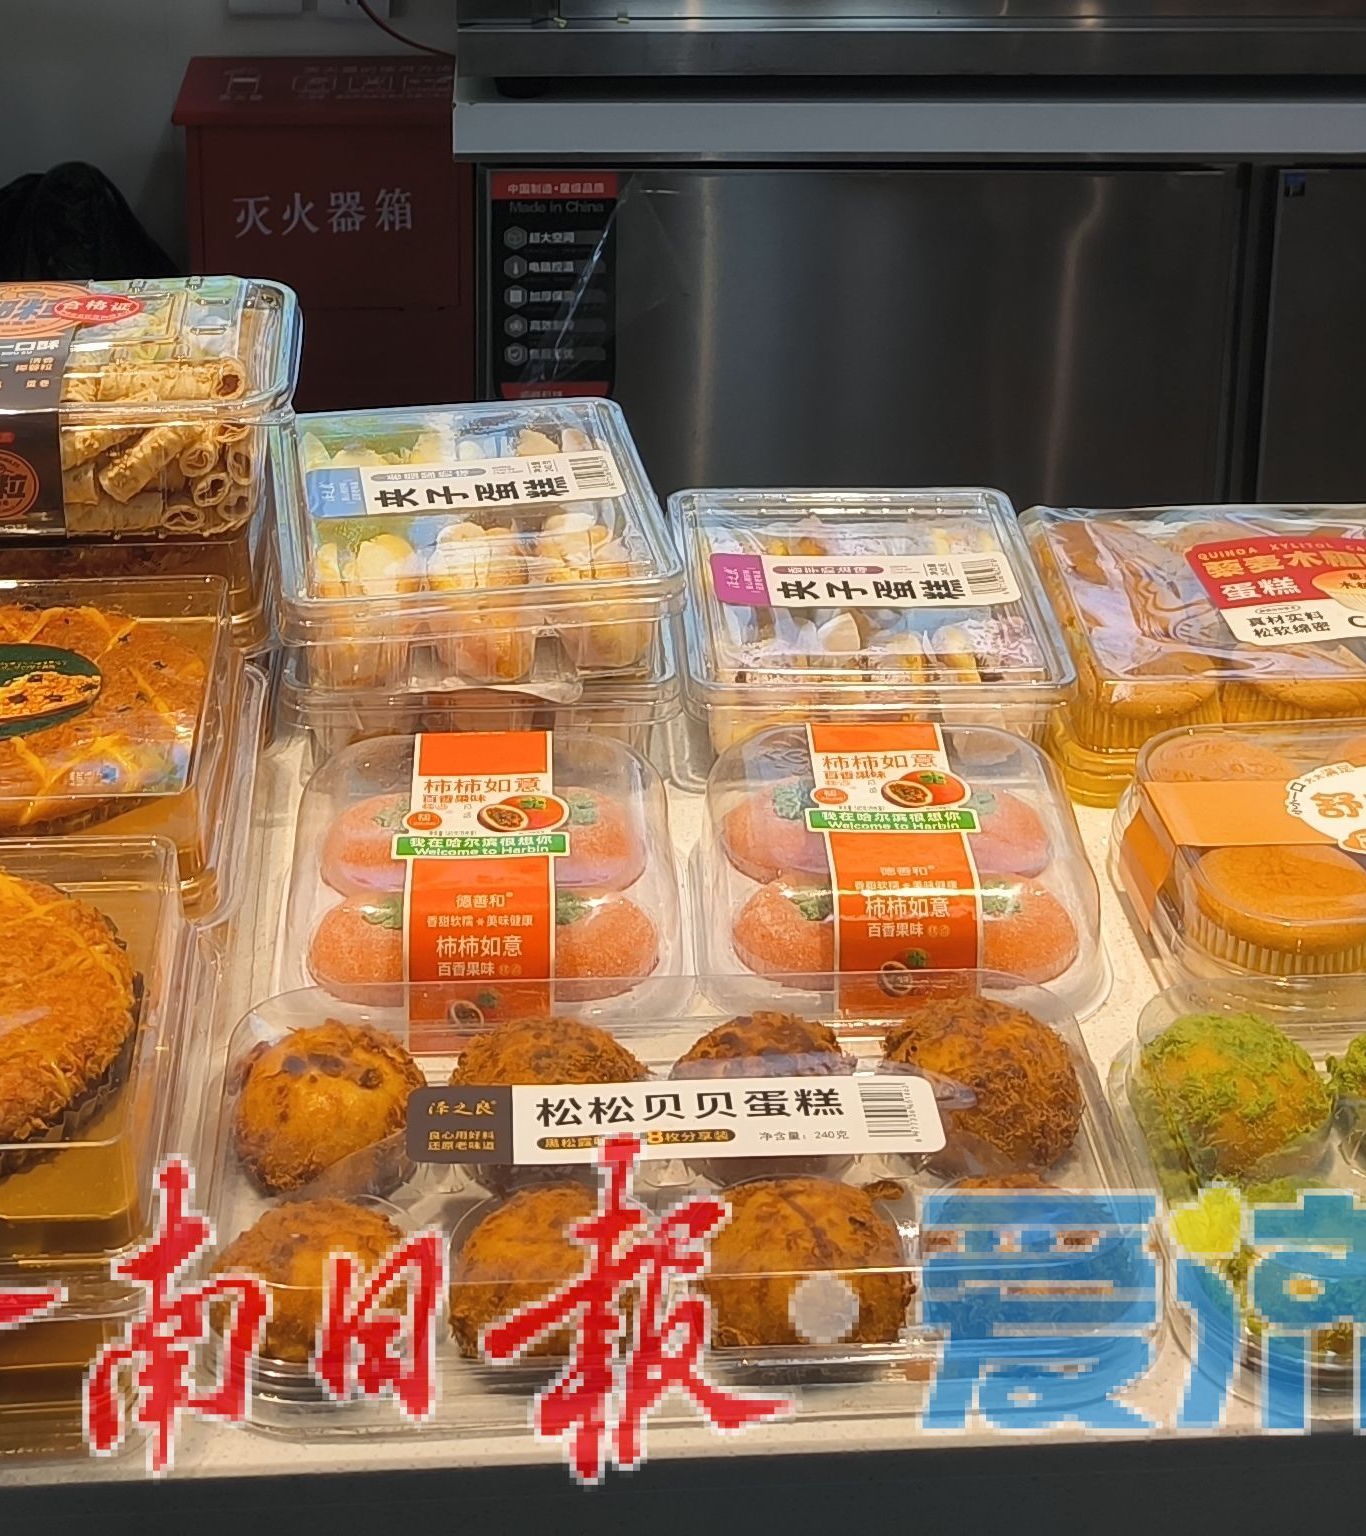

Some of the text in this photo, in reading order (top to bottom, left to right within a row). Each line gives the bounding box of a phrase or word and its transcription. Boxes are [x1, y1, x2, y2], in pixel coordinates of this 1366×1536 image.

[233, 187, 413, 239] 灭火器箱
[509, 201, 546, 214] Made
[565, 201, 604, 214] China
[1198, 546, 1258, 561] QUINOA
[1270, 541, 1335, 552] XYLITOL
[1219, 576, 1302, 602] 蛋糕
[823, 754, 937, 770] 柿柿如意
[424, 777, 541, 794] 柿柿如意
[828, 821, 891, 830] Welcome
[894, 821, 910, 830] to
[414, 845, 549, 856] Welcome to Harbin
[456, 894, 505, 908] 德善和
[866, 897, 950, 918] 柿柿如意
[486, 914, 533, 927] 美味健康
[867, 922, 924, 938] 百香果味
[436, 934, 523, 958] 柿柿如意
[438, 962, 495, 976] 百香果味
[536, 1088, 845, 1128] 松松贝贝蛋糕
[814, 1129, 850, 1141] 240克
